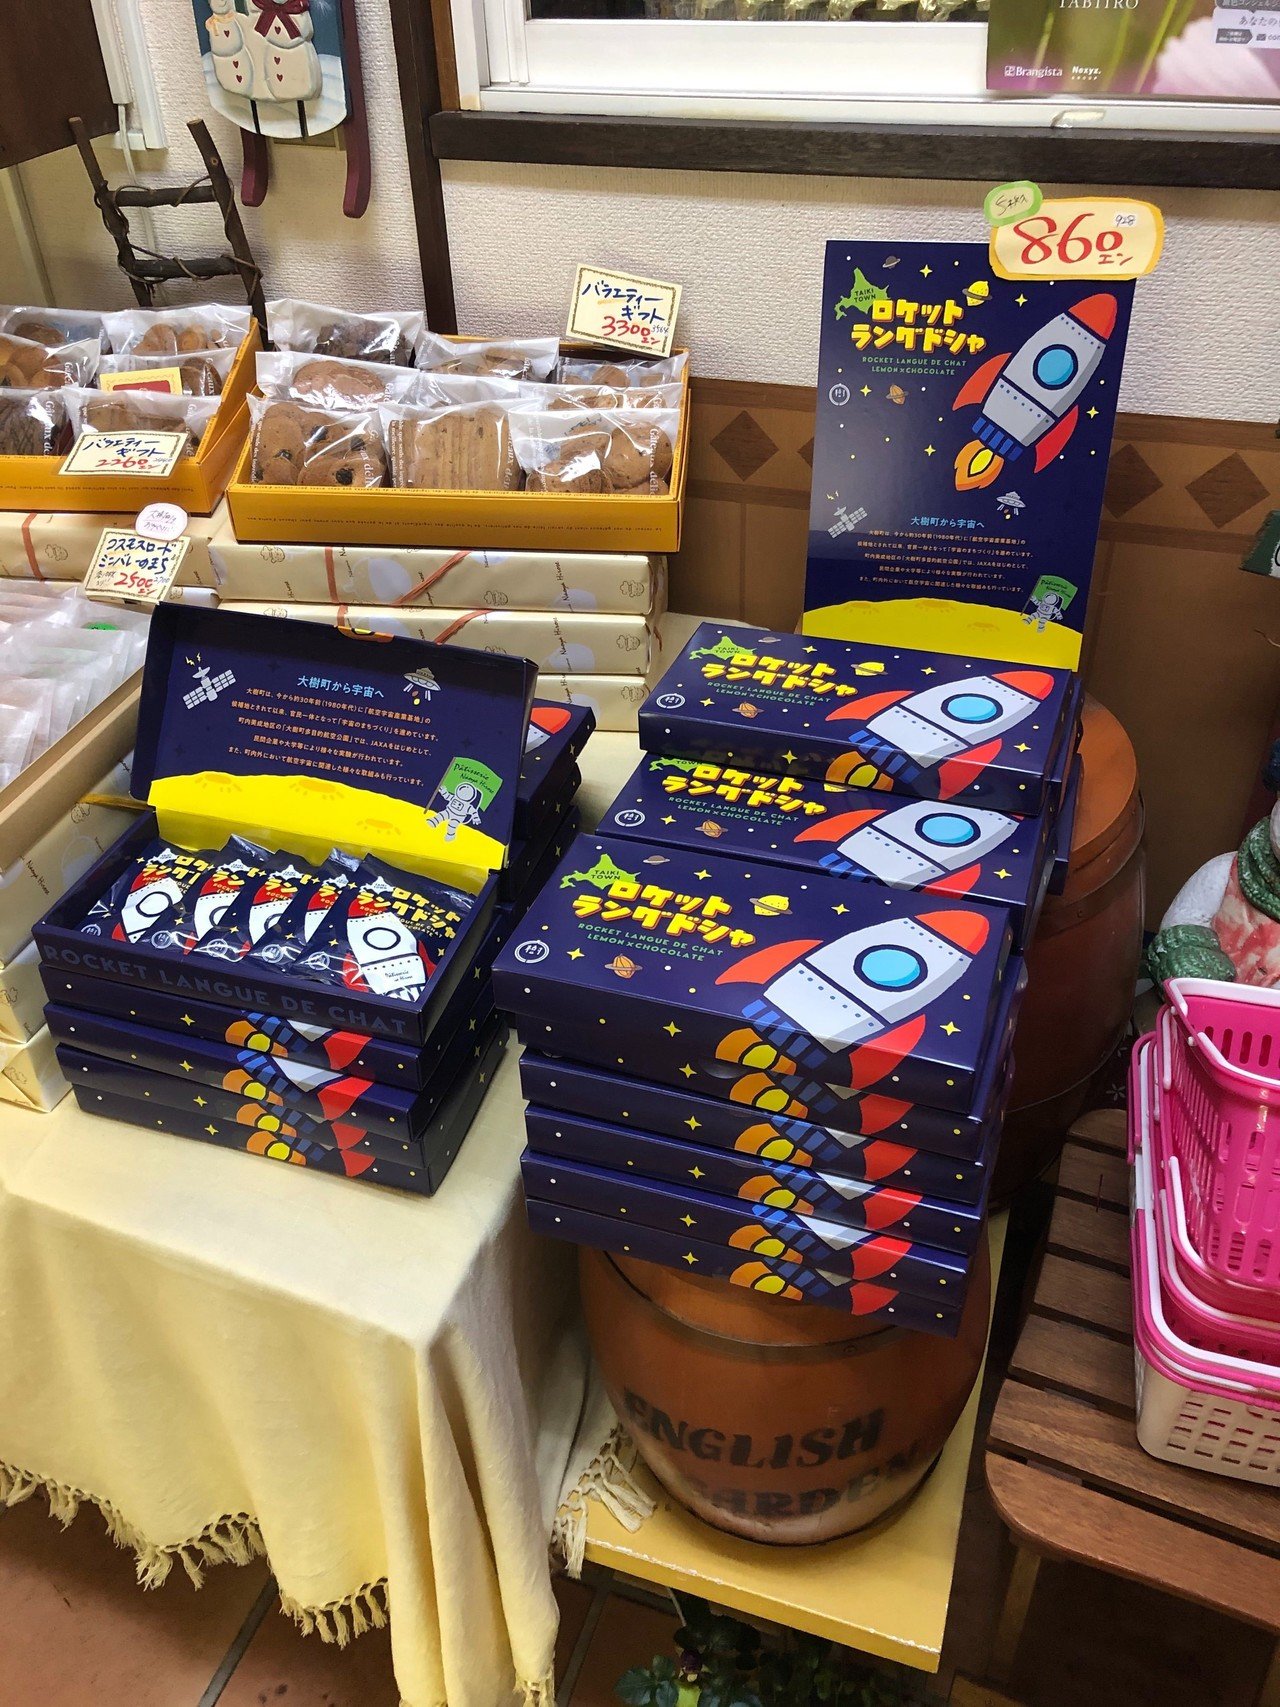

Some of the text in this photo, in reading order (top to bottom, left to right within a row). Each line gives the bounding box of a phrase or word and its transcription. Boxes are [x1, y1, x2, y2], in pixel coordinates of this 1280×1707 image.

[1015, 66, 1063, 78] Brangista
[1115, 214, 1136, 227] 928
[1013, 212, 1123, 265] 860
[581, 279, 664, 305] バラエティー
[854, 294, 876, 302] TOWN
[855, 288, 874, 297] TAIKI
[601, 315, 651, 336] 3300
[621, 305, 665, 324] ギフト
[872, 299, 964, 326] ロケット
[851, 324, 986, 355] ラングドシャ
[862, 356, 893, 364] ROCKET
[82, 437, 160, 451] バラエティー
[116, 447, 166, 457] ギフト
[95, 456, 149, 468] 2260
[910, 516, 985, 529] 大樹町から宇宙へ
[730, 653, 837, 678] ロケット
[297, 675, 385, 699] 大樹町から宇宙へ
[701, 663, 858, 697] ラングドシャ
[707, 681, 745, 691] ROCKET
[747, 687, 785, 697] LANGUE
[805, 694, 831, 703] CHAT
[692, 764, 804, 794] ロケット
[662, 775, 827, 816] ラングドシャ
[668, 796, 799, 822] ROCKET LANGUE DE CHAT
[391, 886, 462, 923] ロケット
[607, 880, 732, 918] ロケット
[356, 890, 457, 939] ラングドシャ
[572, 894, 756, 947] ラングドシャ
[578, 922, 724, 956] ROCKET LANGUE DE CHAT
[43, 944, 408, 1034] ROCKET LANGUE DE CHAT
[624, 1385, 885, 1470] ENGLISH
